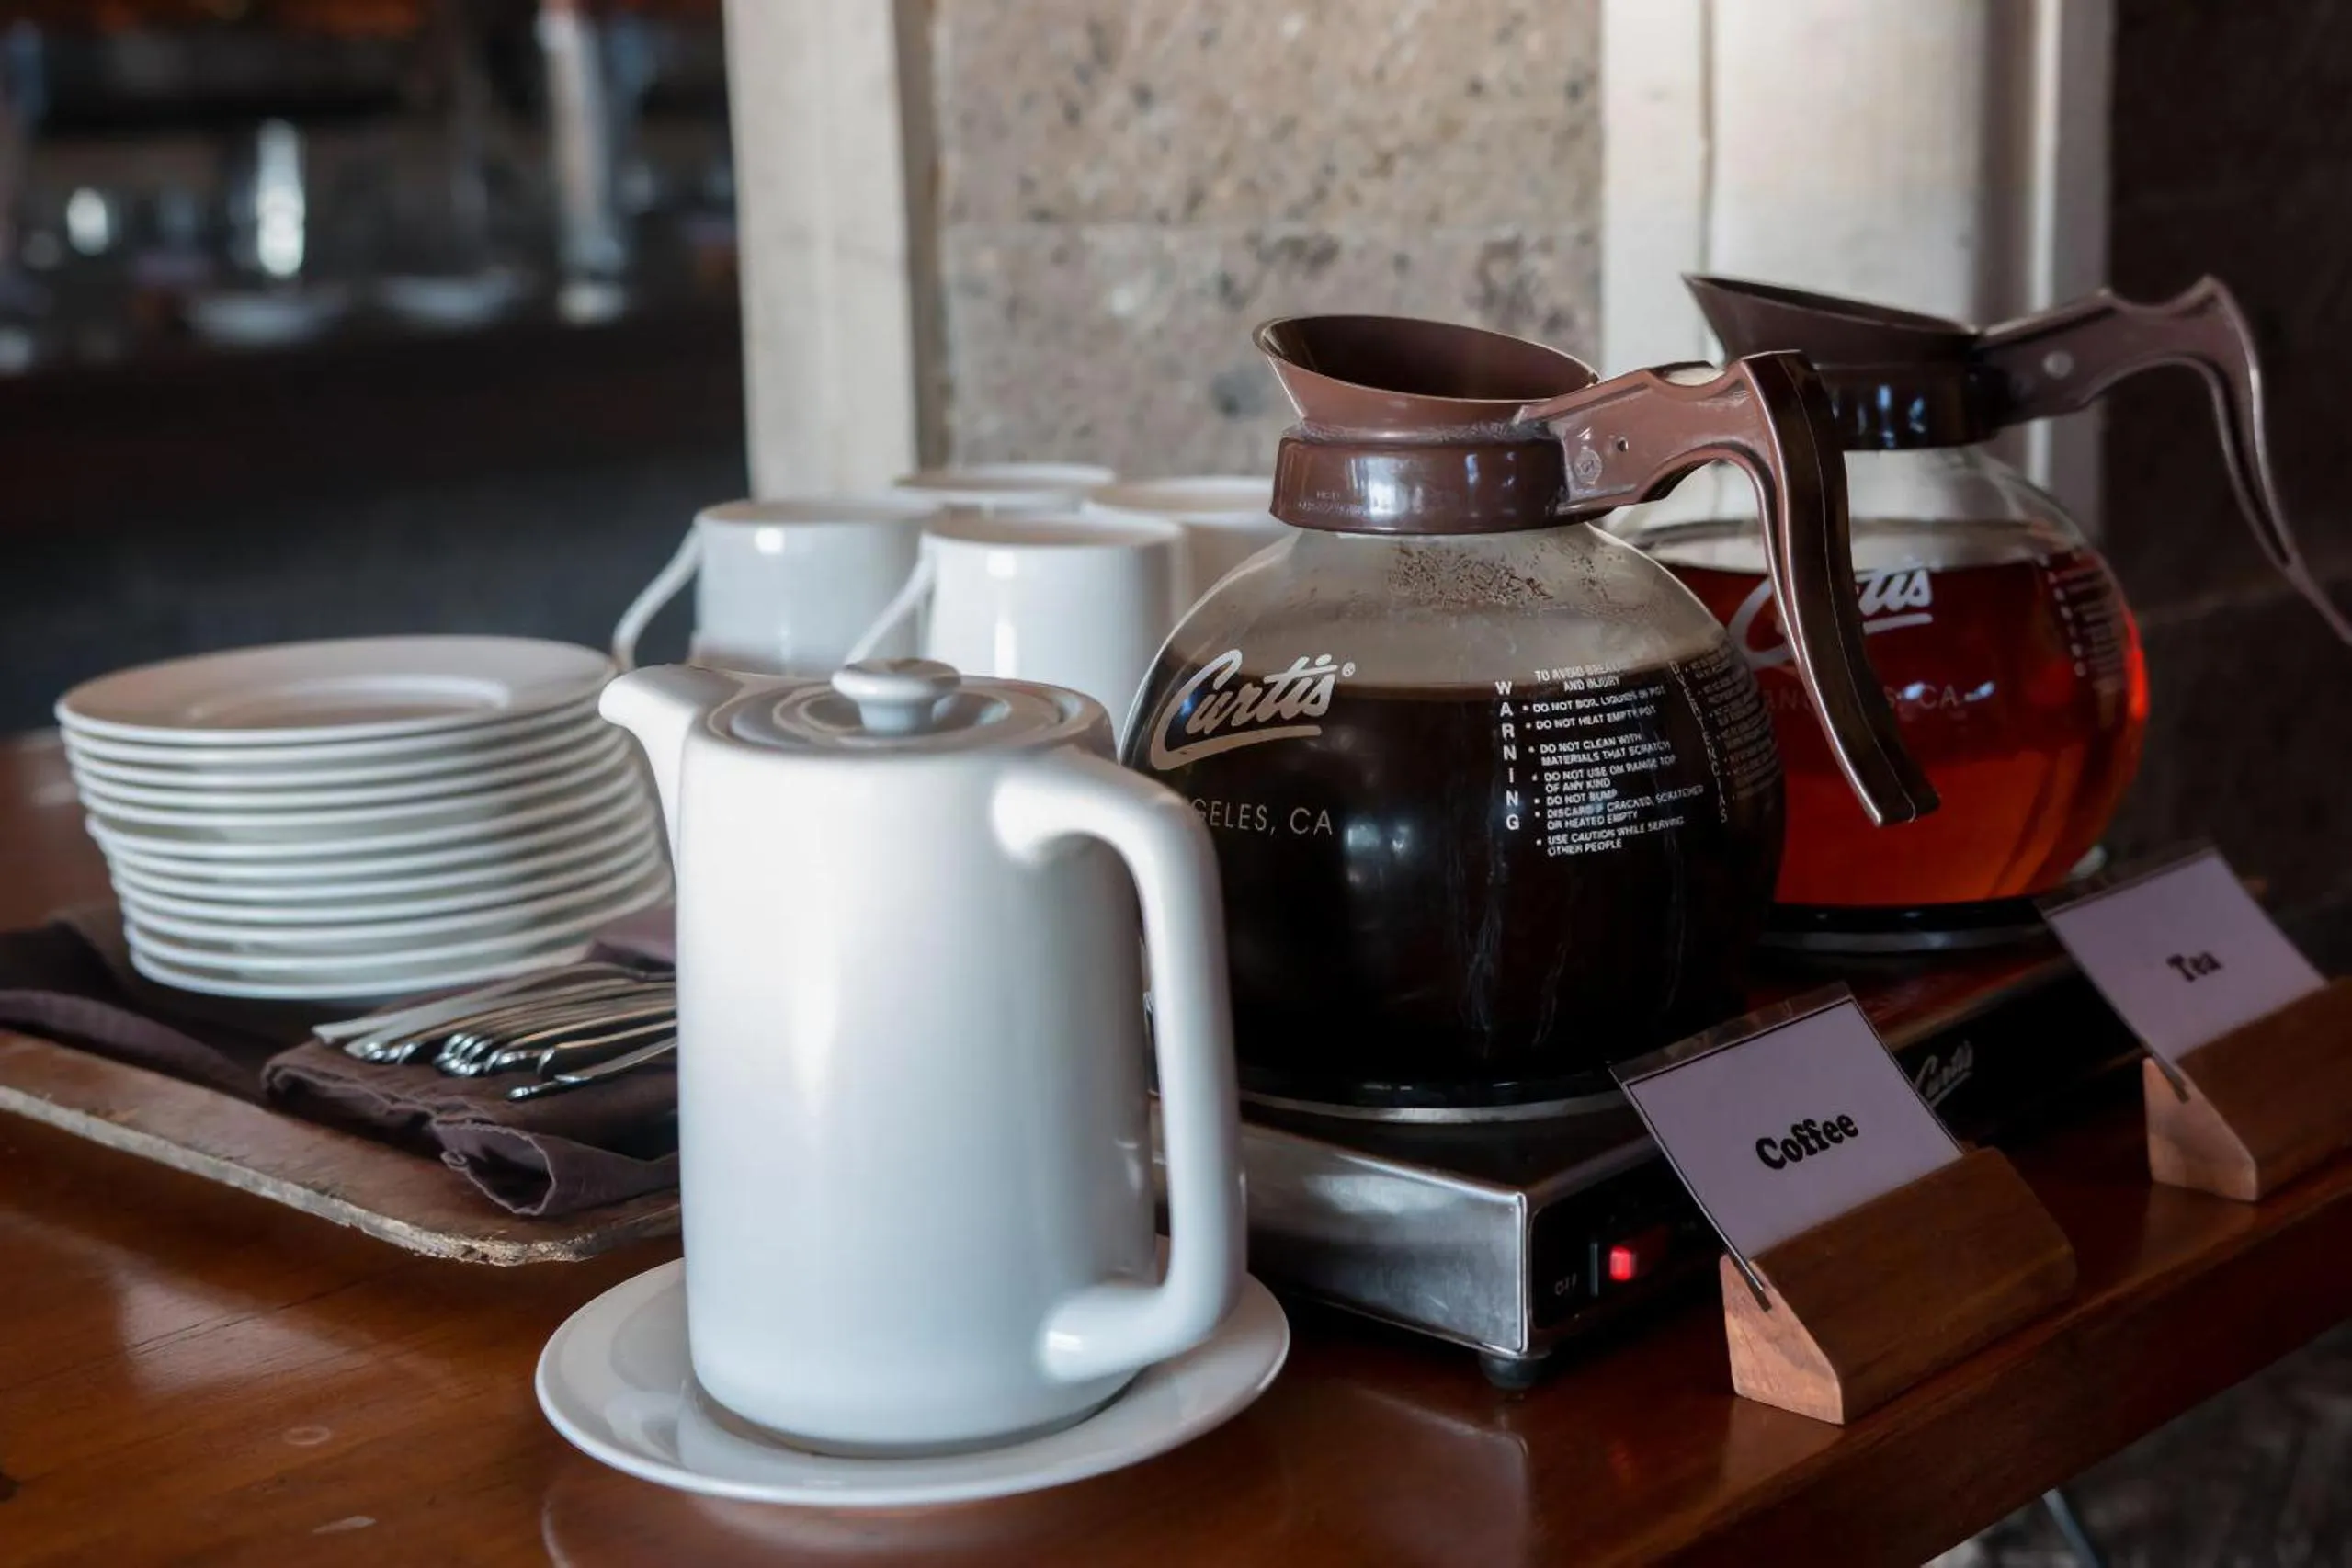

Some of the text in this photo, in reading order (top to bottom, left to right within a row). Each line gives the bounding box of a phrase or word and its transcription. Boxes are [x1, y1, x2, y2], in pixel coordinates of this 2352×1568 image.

[1534, 669, 1550, 682] TO
[1552, 665, 1585, 680] AVOID
[1563, 676, 1620, 692] AND INJURY
[1533, 702, 1550, 713] DO
[1552, 700, 1574, 711] NOT
[1575, 699, 1599, 710] BOIL
[1536, 705, 1657, 730] DO NOT HEAT EMPTY POT
[1494, 681, 1519, 830] WARNING
[1540, 733, 1642, 754] DO NOT CLEAN WITH
[1541, 740, 1671, 767] MATERIALS THAT SCRATCH
[1544, 755, 1676, 781] DO NOT USE ON RANGE TOP
[1545, 778, 1610, 793] OF ANY KIND
[1547, 789, 1618, 806] DO NOT BUMP
[1547, 804, 1594, 819] DISCARD
[1655, 785, 1704, 803] SCRATCHED
[1290, 807, 1333, 835] CA
[1547, 810, 1638, 831] OR HEATED EMPTY
[1548, 816, 1685, 845] USE CAUTION WHILE SERVING
[1547, 838, 1622, 857] OTHER PEOPLE
[2165, 951, 2223, 983] Tea
[1755, 1113, 1859, 1170] Coffee
